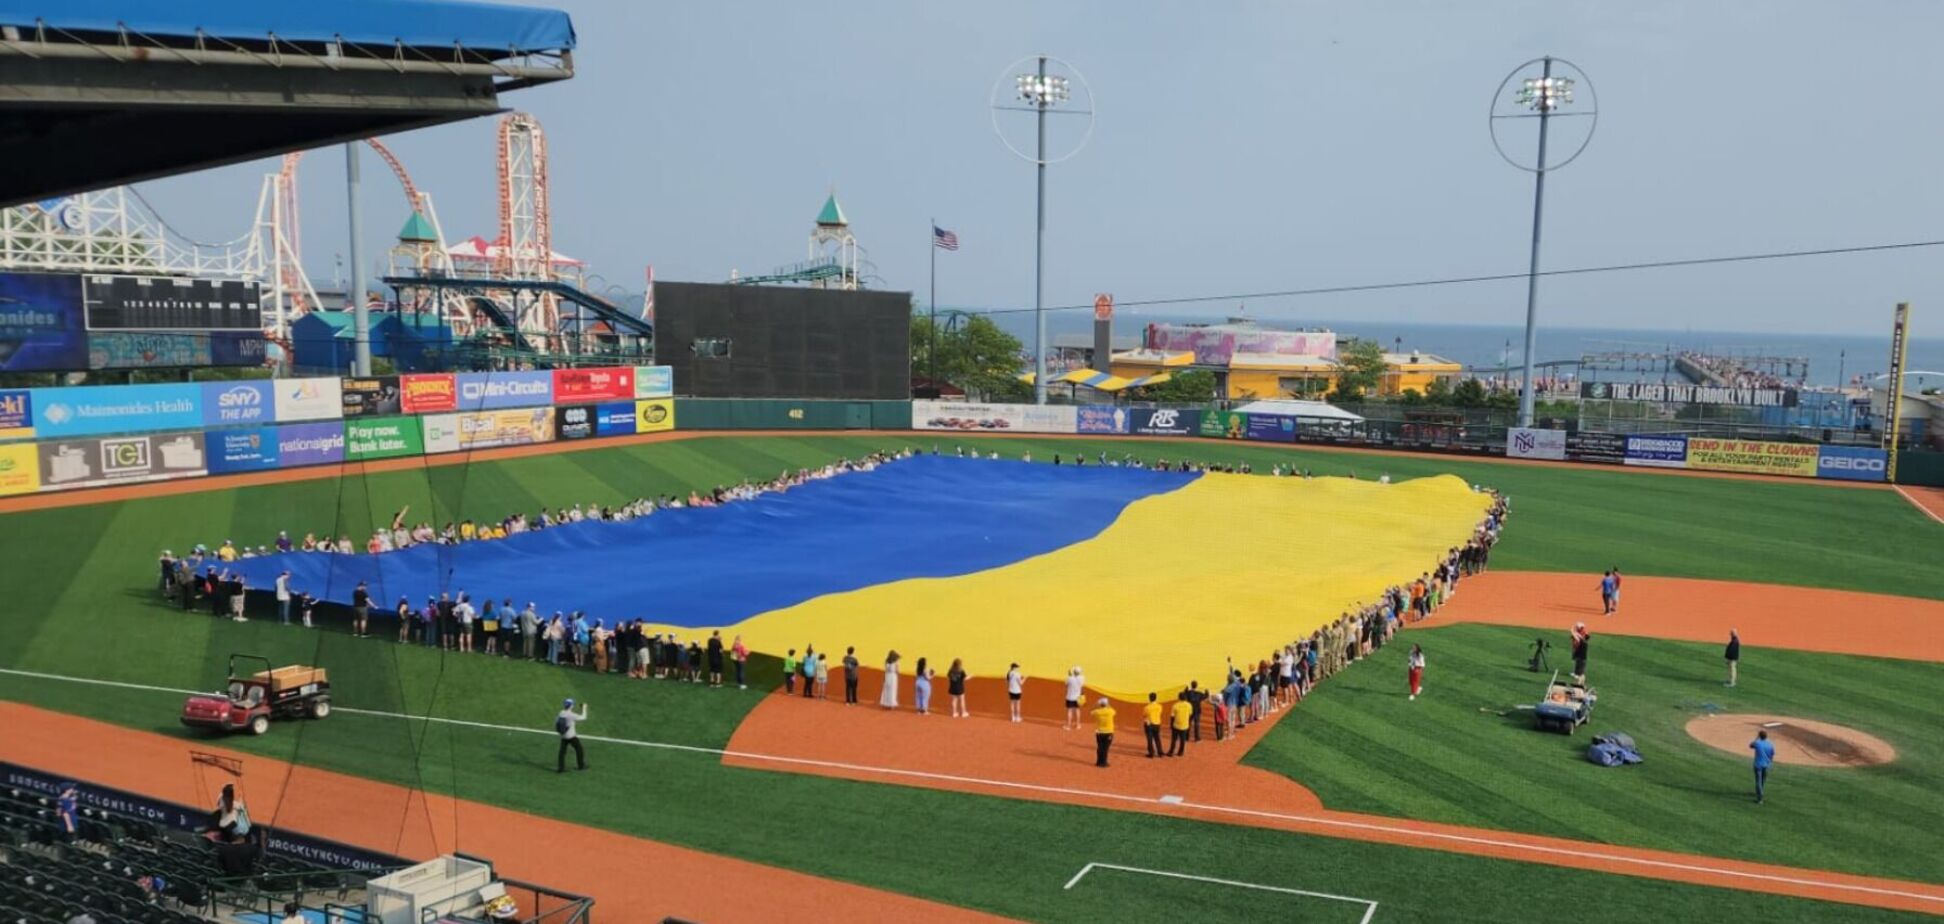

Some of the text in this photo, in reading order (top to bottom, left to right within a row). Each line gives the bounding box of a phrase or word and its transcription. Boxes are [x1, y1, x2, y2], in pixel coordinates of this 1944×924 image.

[240, 339, 264, 358] MPH
[480, 379, 549, 396] Mini-Circuits
[1611, 383, 1785, 406] THE LAGER THAT BROOKLYN BUILT
[77, 397, 193, 417] Maimonides Health
[218, 391, 253, 408] SNY
[220, 407, 262, 420] THE APP
[349, 424, 400, 440] Play now.
[280, 434, 343, 455] nationalgrid
[350, 440, 378, 453] Bank
[1690, 440, 1817, 456] SEND IN THE CLOWNS
[107, 443, 145, 466] TGI
[1820, 455, 1885, 471] GEICO
